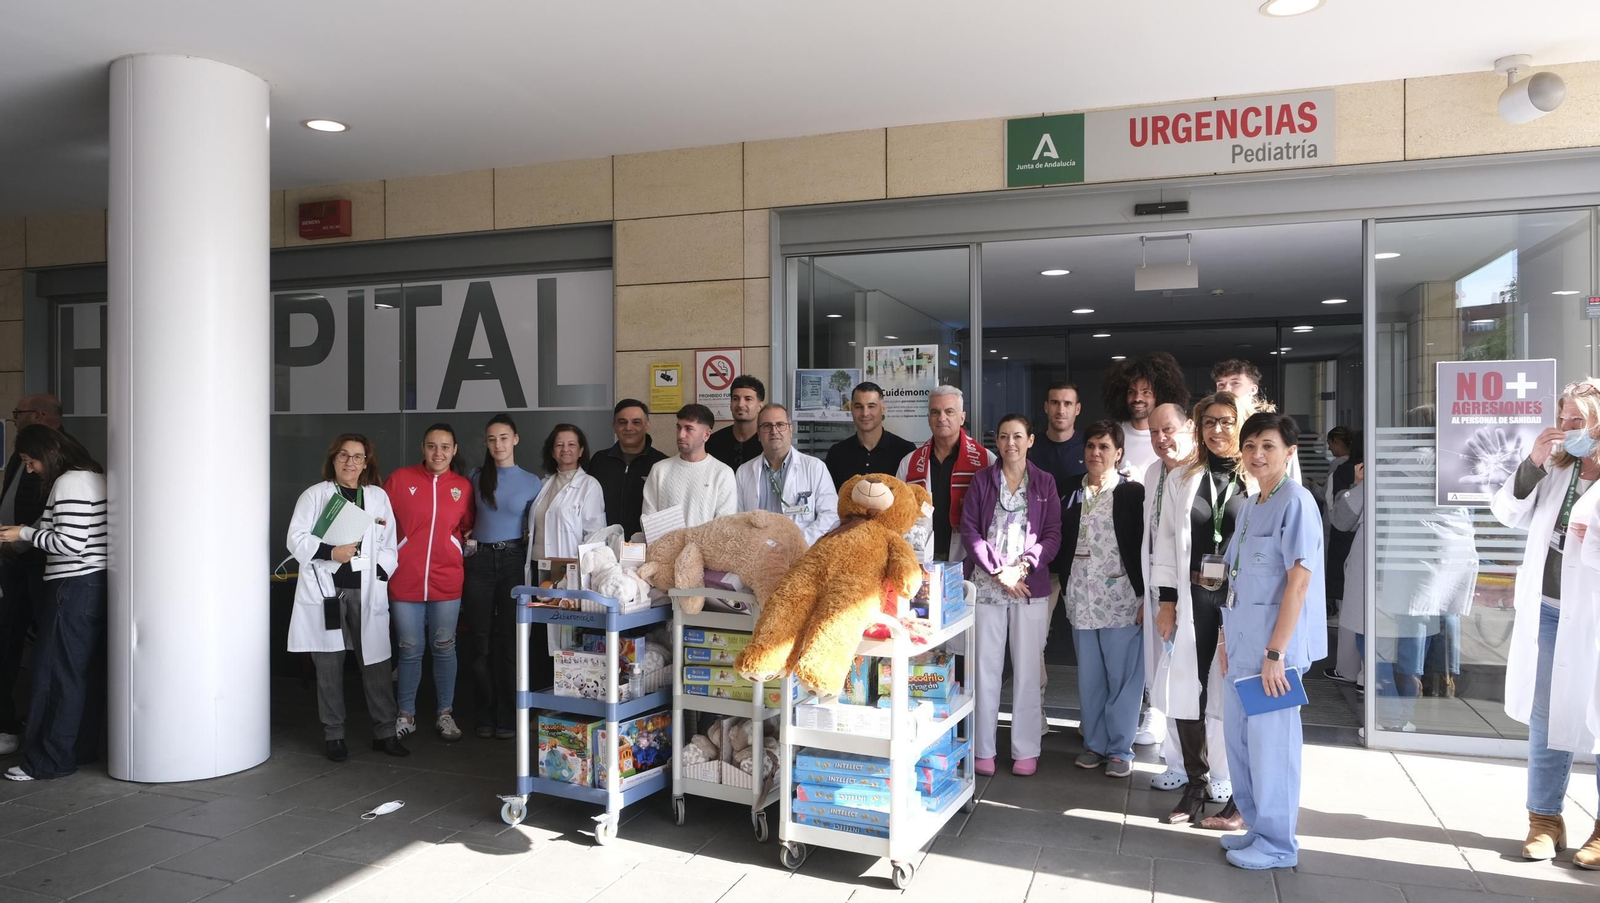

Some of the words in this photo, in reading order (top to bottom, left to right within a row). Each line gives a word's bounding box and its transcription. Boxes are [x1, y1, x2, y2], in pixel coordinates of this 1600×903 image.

[1129, 101, 1318, 147] URGENCIAS
[1231, 139, 1318, 164] Pediatría
[1044, 159, 1076, 168] Andalucía
[881, 388, 930, 397] Cuidémono
[1451, 401, 1542, 415] AGRESIONES
[1509, 416, 1542, 424] SANIDAD
[908, 672, 945, 683] ocodrilo
[834, 762, 864, 771] INTELECT
[828, 775, 857, 784] INTELECT
[829, 808, 859, 817] INTELECT
